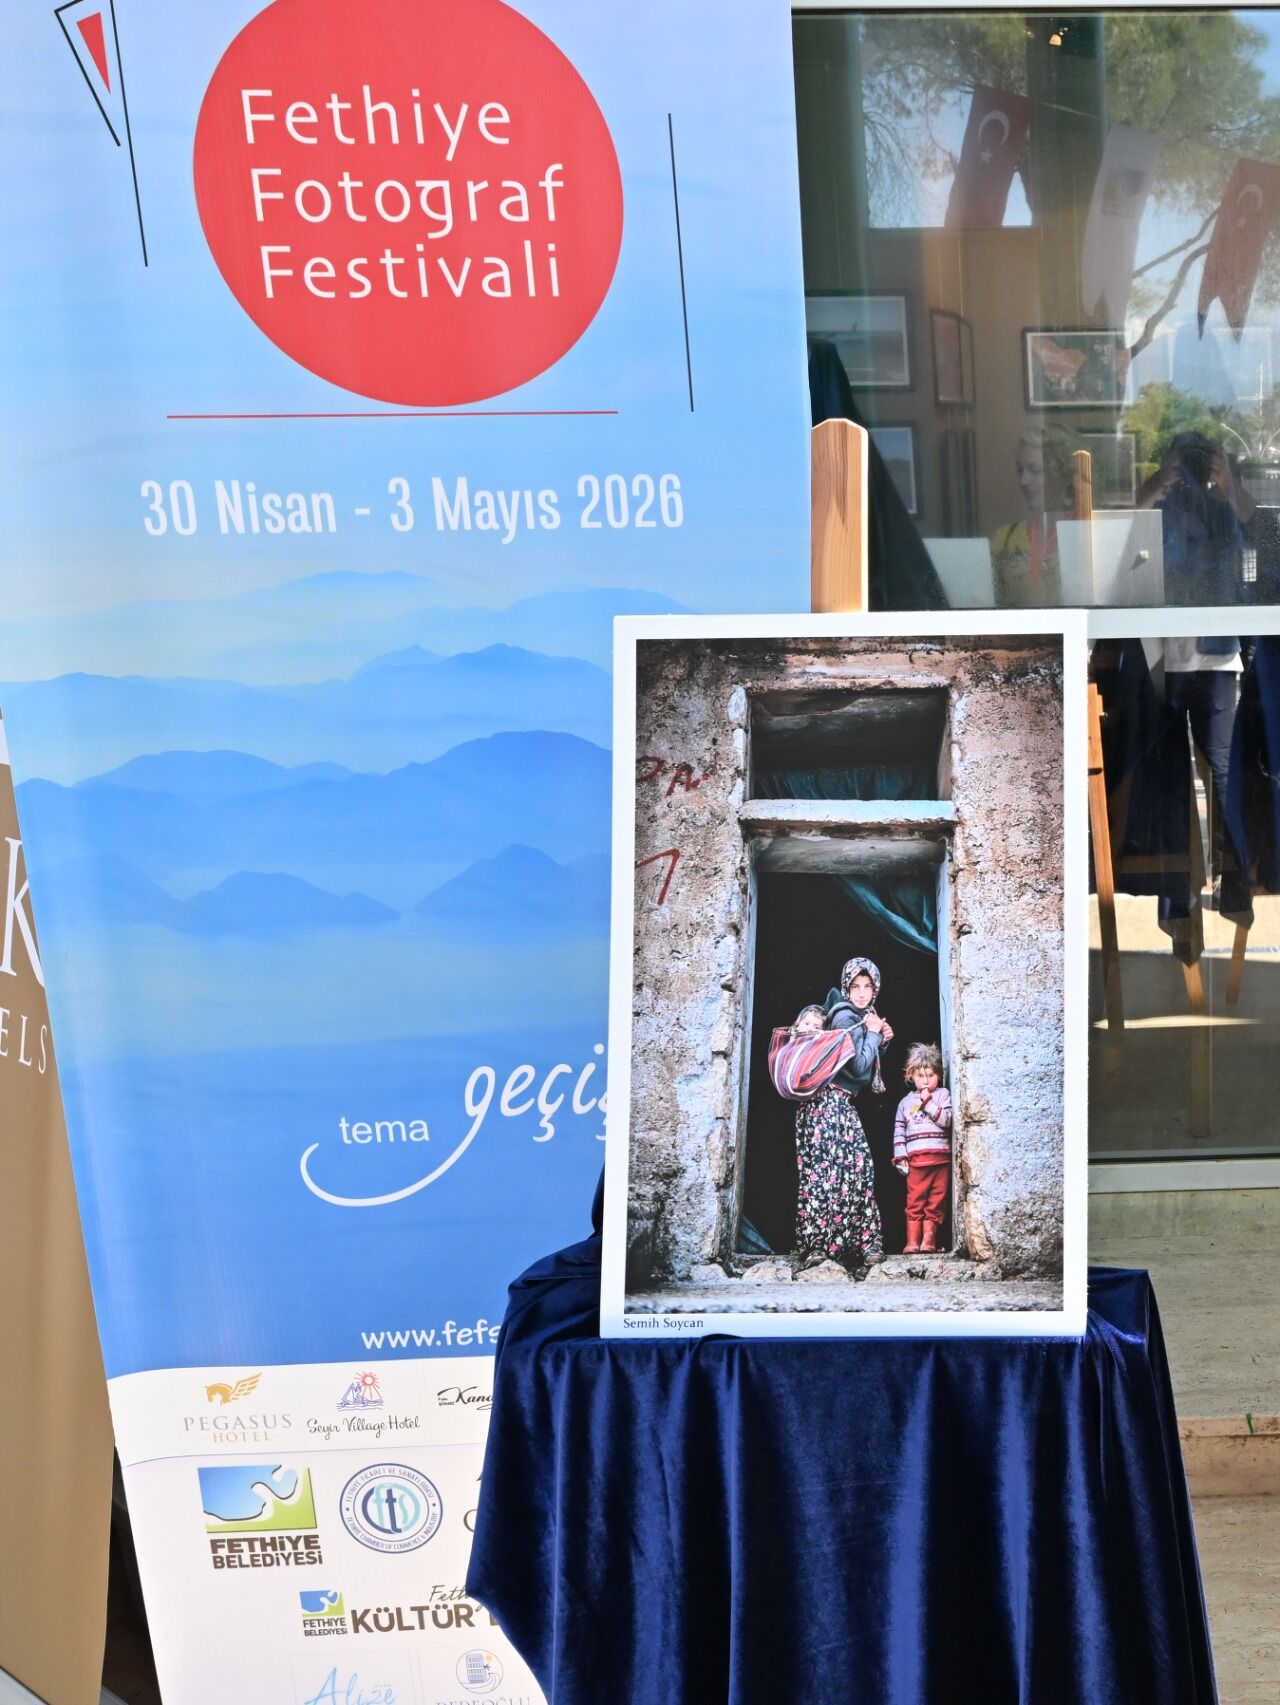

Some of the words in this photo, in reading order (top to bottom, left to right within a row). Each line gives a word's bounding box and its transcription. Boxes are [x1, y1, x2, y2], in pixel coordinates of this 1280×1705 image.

[241, 85, 511, 161] Fethiye
[260, 240, 561, 299] Festivali
[140, 480, 197, 536] 30
[214, 480, 336, 534] Nisan
[388, 477, 415, 533] 3
[432, 476, 561, 544] Mayıs
[576, 473, 685, 531] 2026
[339, 1117, 430, 1144] tema
[623, 1317, 659, 1328] Semih
[663, 1318, 704, 1331] Soycan
[183, 1414, 292, 1432] PEGASUS
[306, 1418, 340, 1440] Seyir
[343, 1416, 386, 1438] Village
[388, 1415, 420, 1431] Hotel
[213, 1430, 272, 1443] HOTEL
